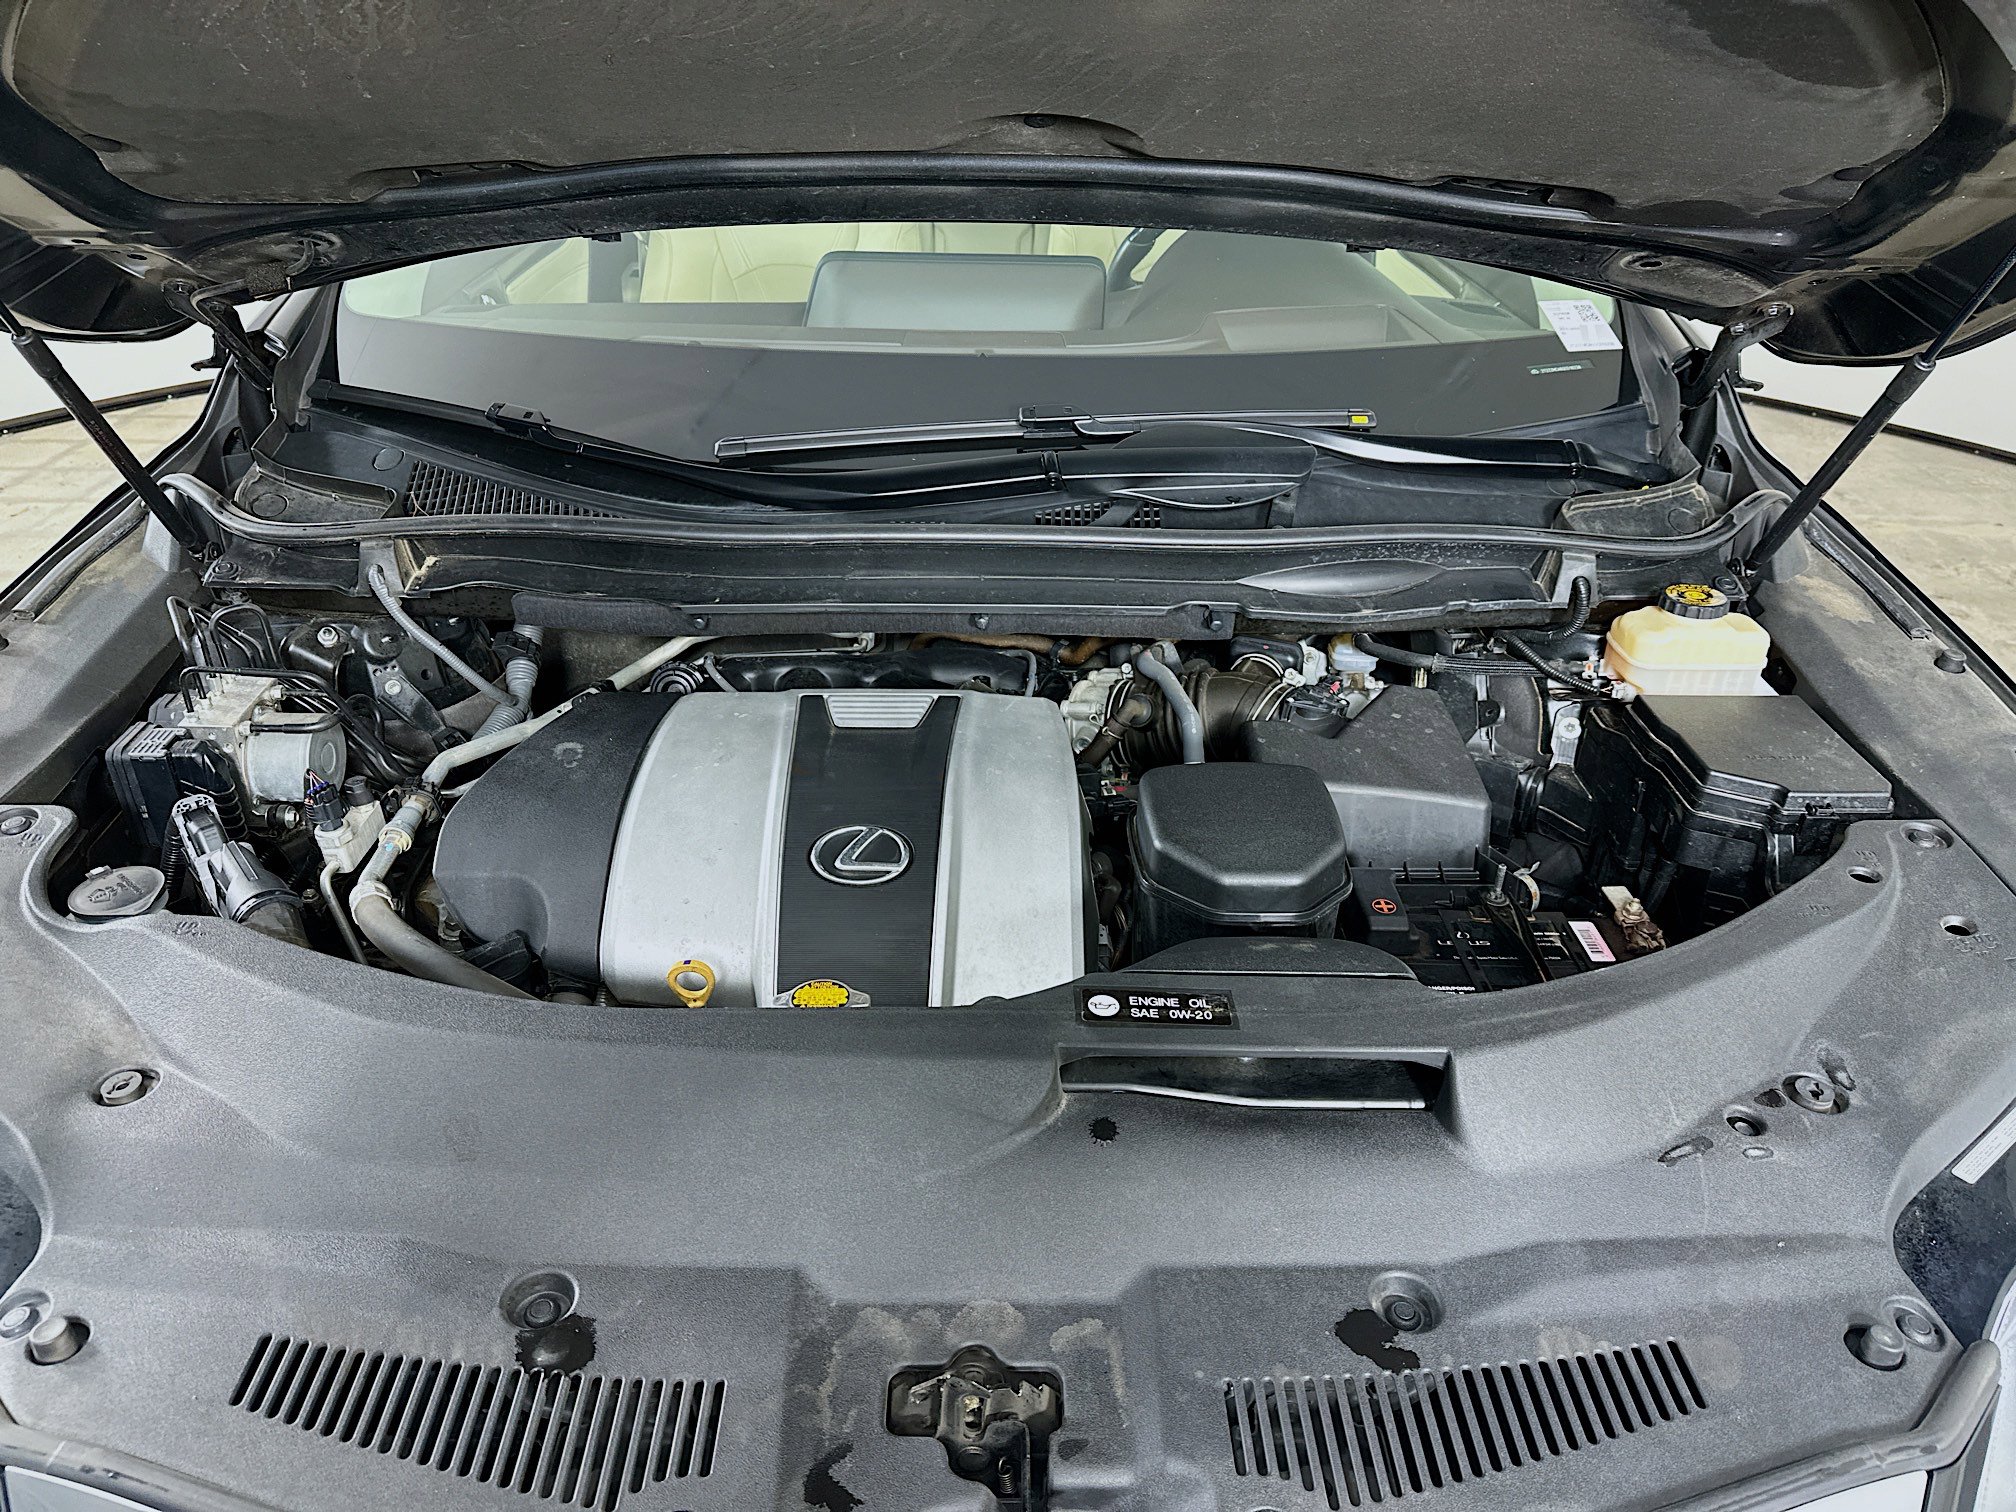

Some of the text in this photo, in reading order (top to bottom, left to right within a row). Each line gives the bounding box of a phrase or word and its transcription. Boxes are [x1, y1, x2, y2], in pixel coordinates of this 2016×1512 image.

[1128, 996, 1213, 1009] ENGINE OIL
[1130, 1008, 1213, 1021] SAE 0W-20
